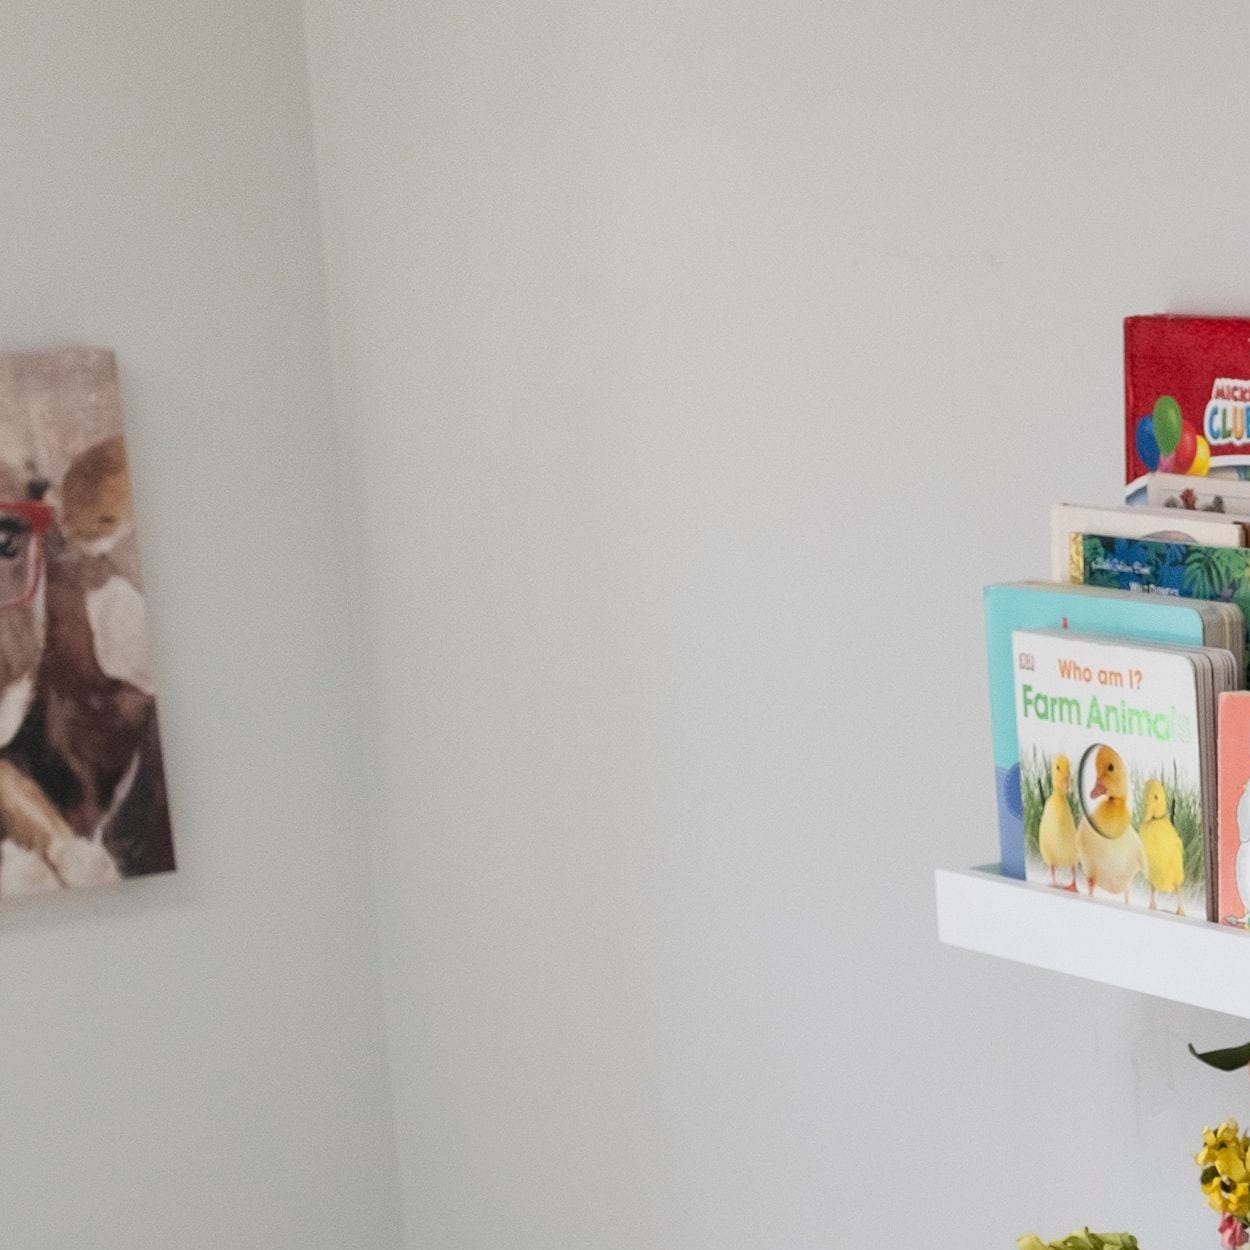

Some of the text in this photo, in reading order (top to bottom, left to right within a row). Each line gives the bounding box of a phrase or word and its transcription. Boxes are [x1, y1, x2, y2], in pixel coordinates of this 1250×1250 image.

[1058, 658, 1143, 690] Who am I?
[1022, 684, 1081, 726] Farm
